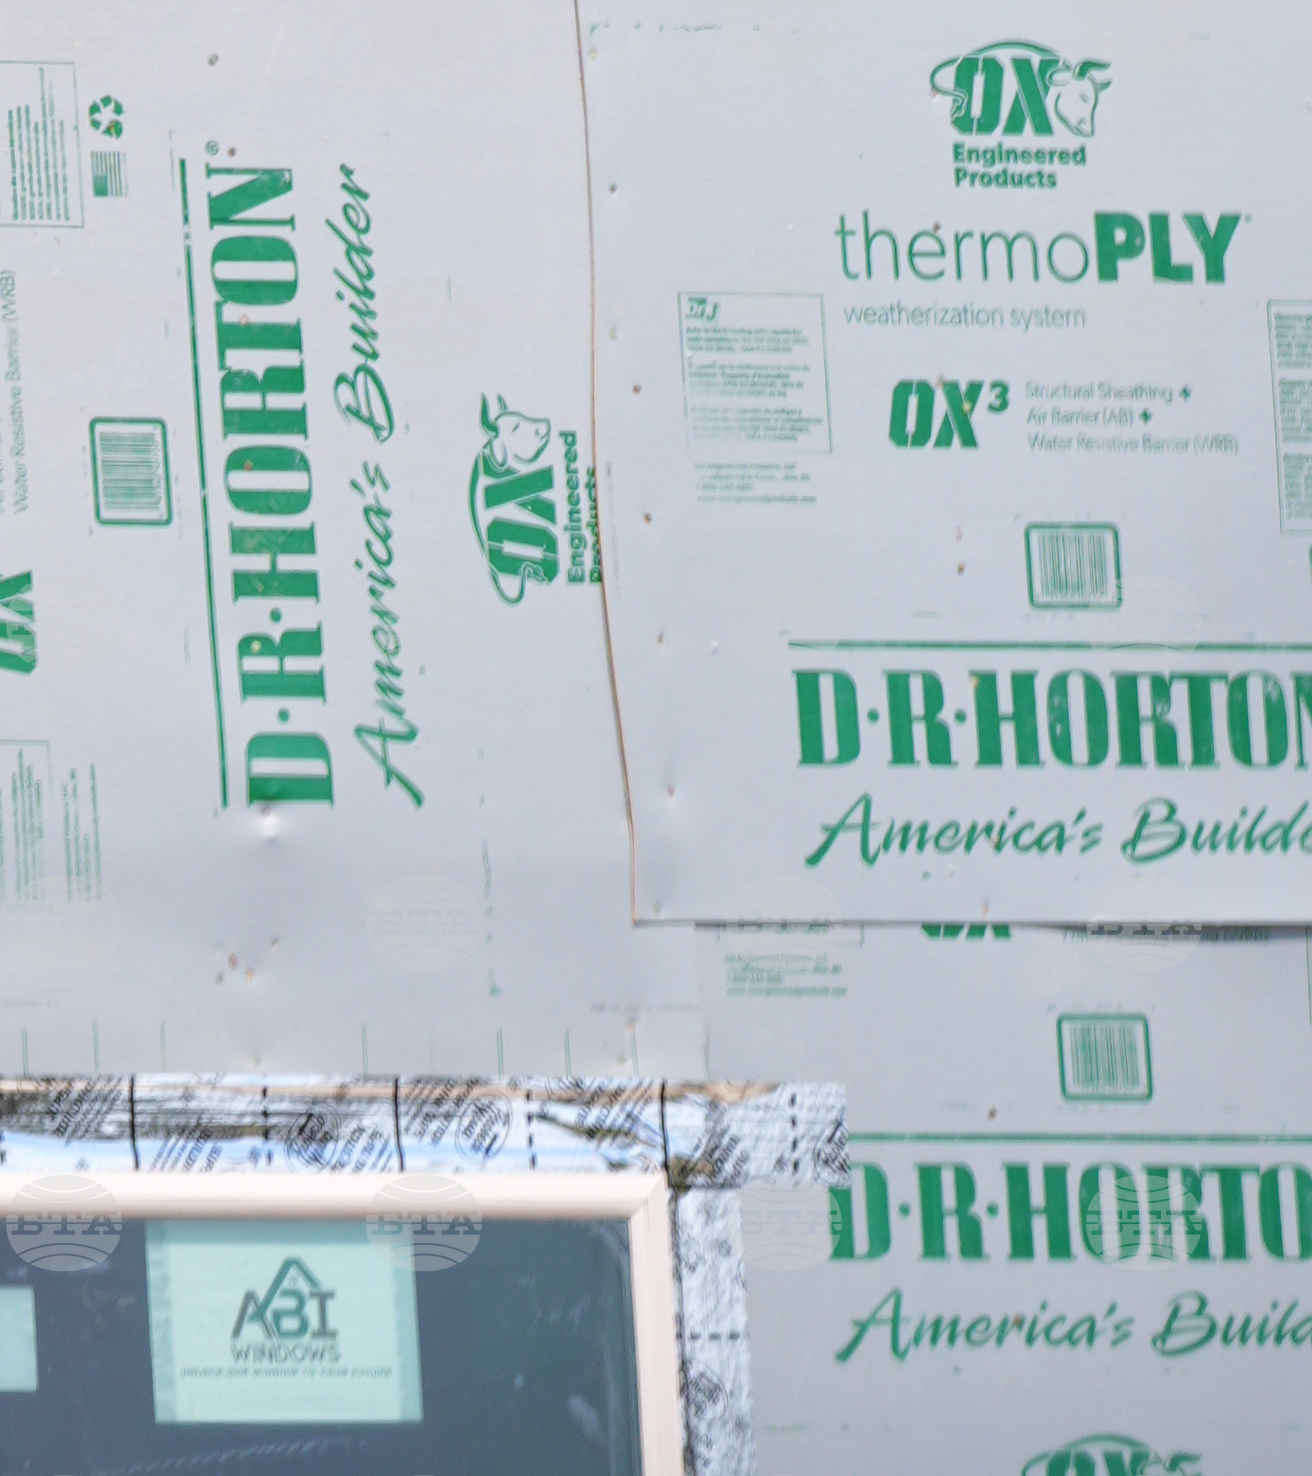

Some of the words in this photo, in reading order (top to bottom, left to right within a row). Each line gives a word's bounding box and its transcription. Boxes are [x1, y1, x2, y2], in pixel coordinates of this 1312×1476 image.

[837, 213, 1240, 283] thermoPLY
[326, 165, 394, 443] Builder
[350, 464, 424, 808] America's
[806, 795, 1101, 868] America's
[230, 1341, 340, 1366] WINDOWS
